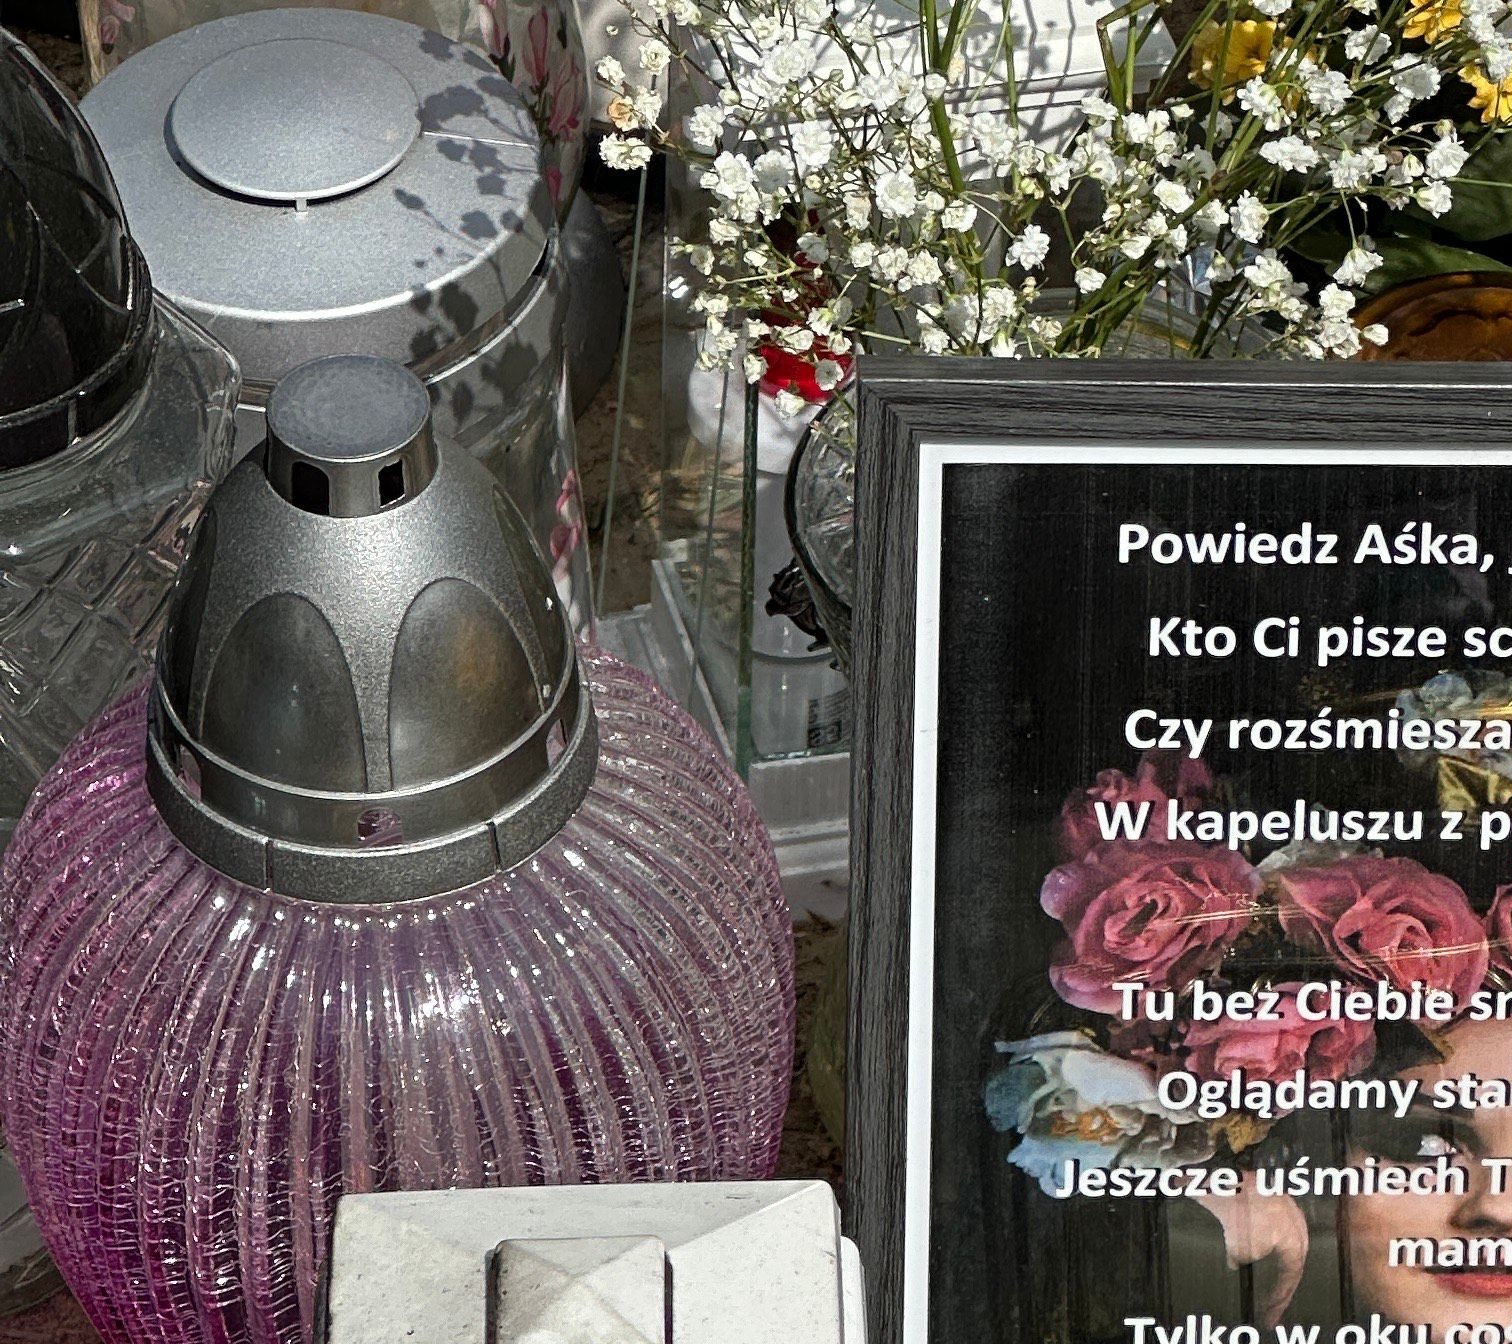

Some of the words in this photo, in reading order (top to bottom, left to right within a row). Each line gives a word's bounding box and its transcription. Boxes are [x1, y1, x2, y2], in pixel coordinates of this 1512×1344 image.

[1117, 522, 1340, 566] Powiedz
[1353, 520, 1495, 574] Aśka,
[1149, 617, 1237, 657] Kto
[1252, 616, 1300, 658] Ci
[1317, 616, 1448, 668] pisze
[1123, 708, 1212, 760] Czy
[1095, 801, 1150, 841] W
[1165, 799, 1424, 851] kapeluszu
[1439, 810, 1464, 841] z
[1112, 982, 1177, 1023] Tu
[1192, 982, 1282, 1023] bez
[1295, 981, 1455, 1023] Ciebie
[1156, 1069, 1416, 1121] Oglądamy
[1054, 1160, 1240, 1205] Jeszcze
[1255, 1155, 1468, 1199] uśmiech
